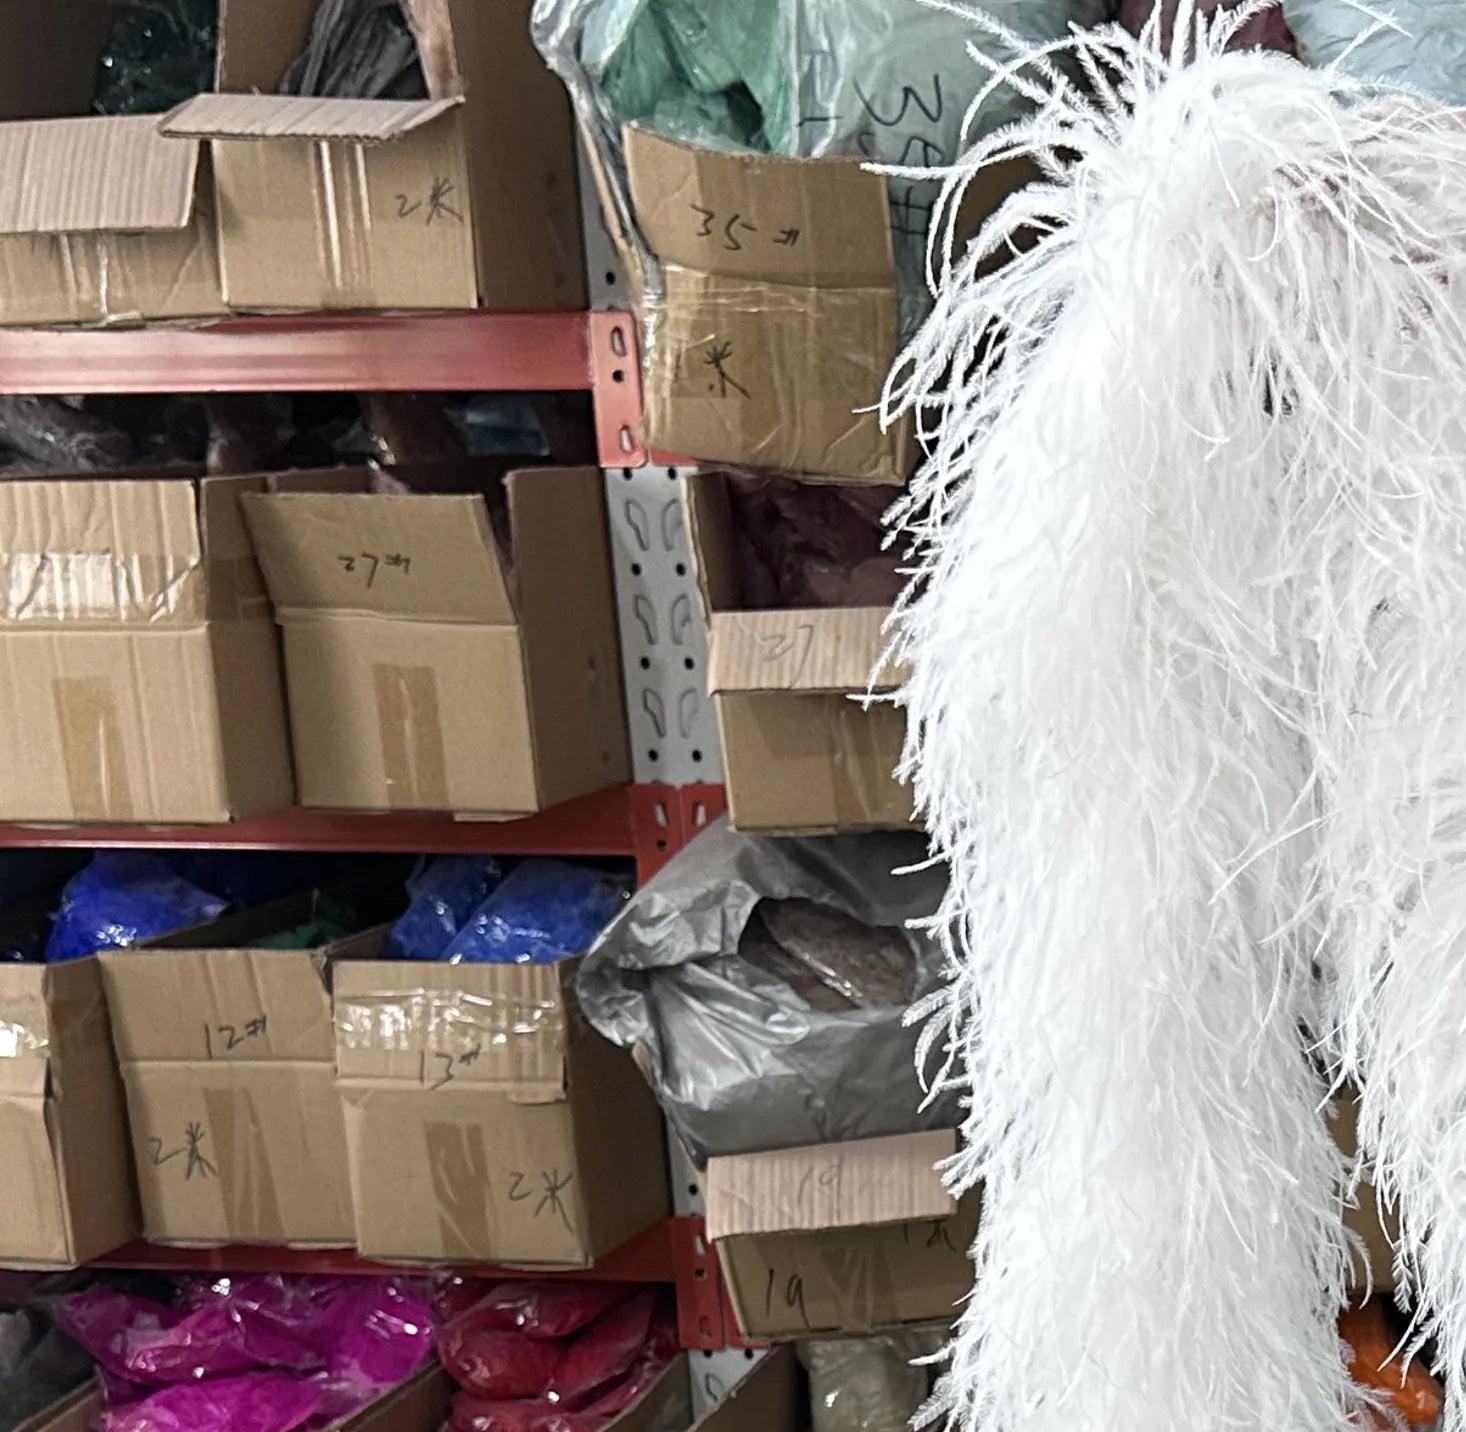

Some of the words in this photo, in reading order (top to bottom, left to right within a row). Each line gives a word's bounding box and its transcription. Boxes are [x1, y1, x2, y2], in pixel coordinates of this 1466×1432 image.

[394, 176, 465, 227] 2米
[204, 1014, 267, 1060] 12#
[149, 1120, 221, 1181] 2米
[508, 1168, 575, 1238] 2米
[797, 1154, 845, 1224] 19
[765, 1267, 812, 1331] 19
